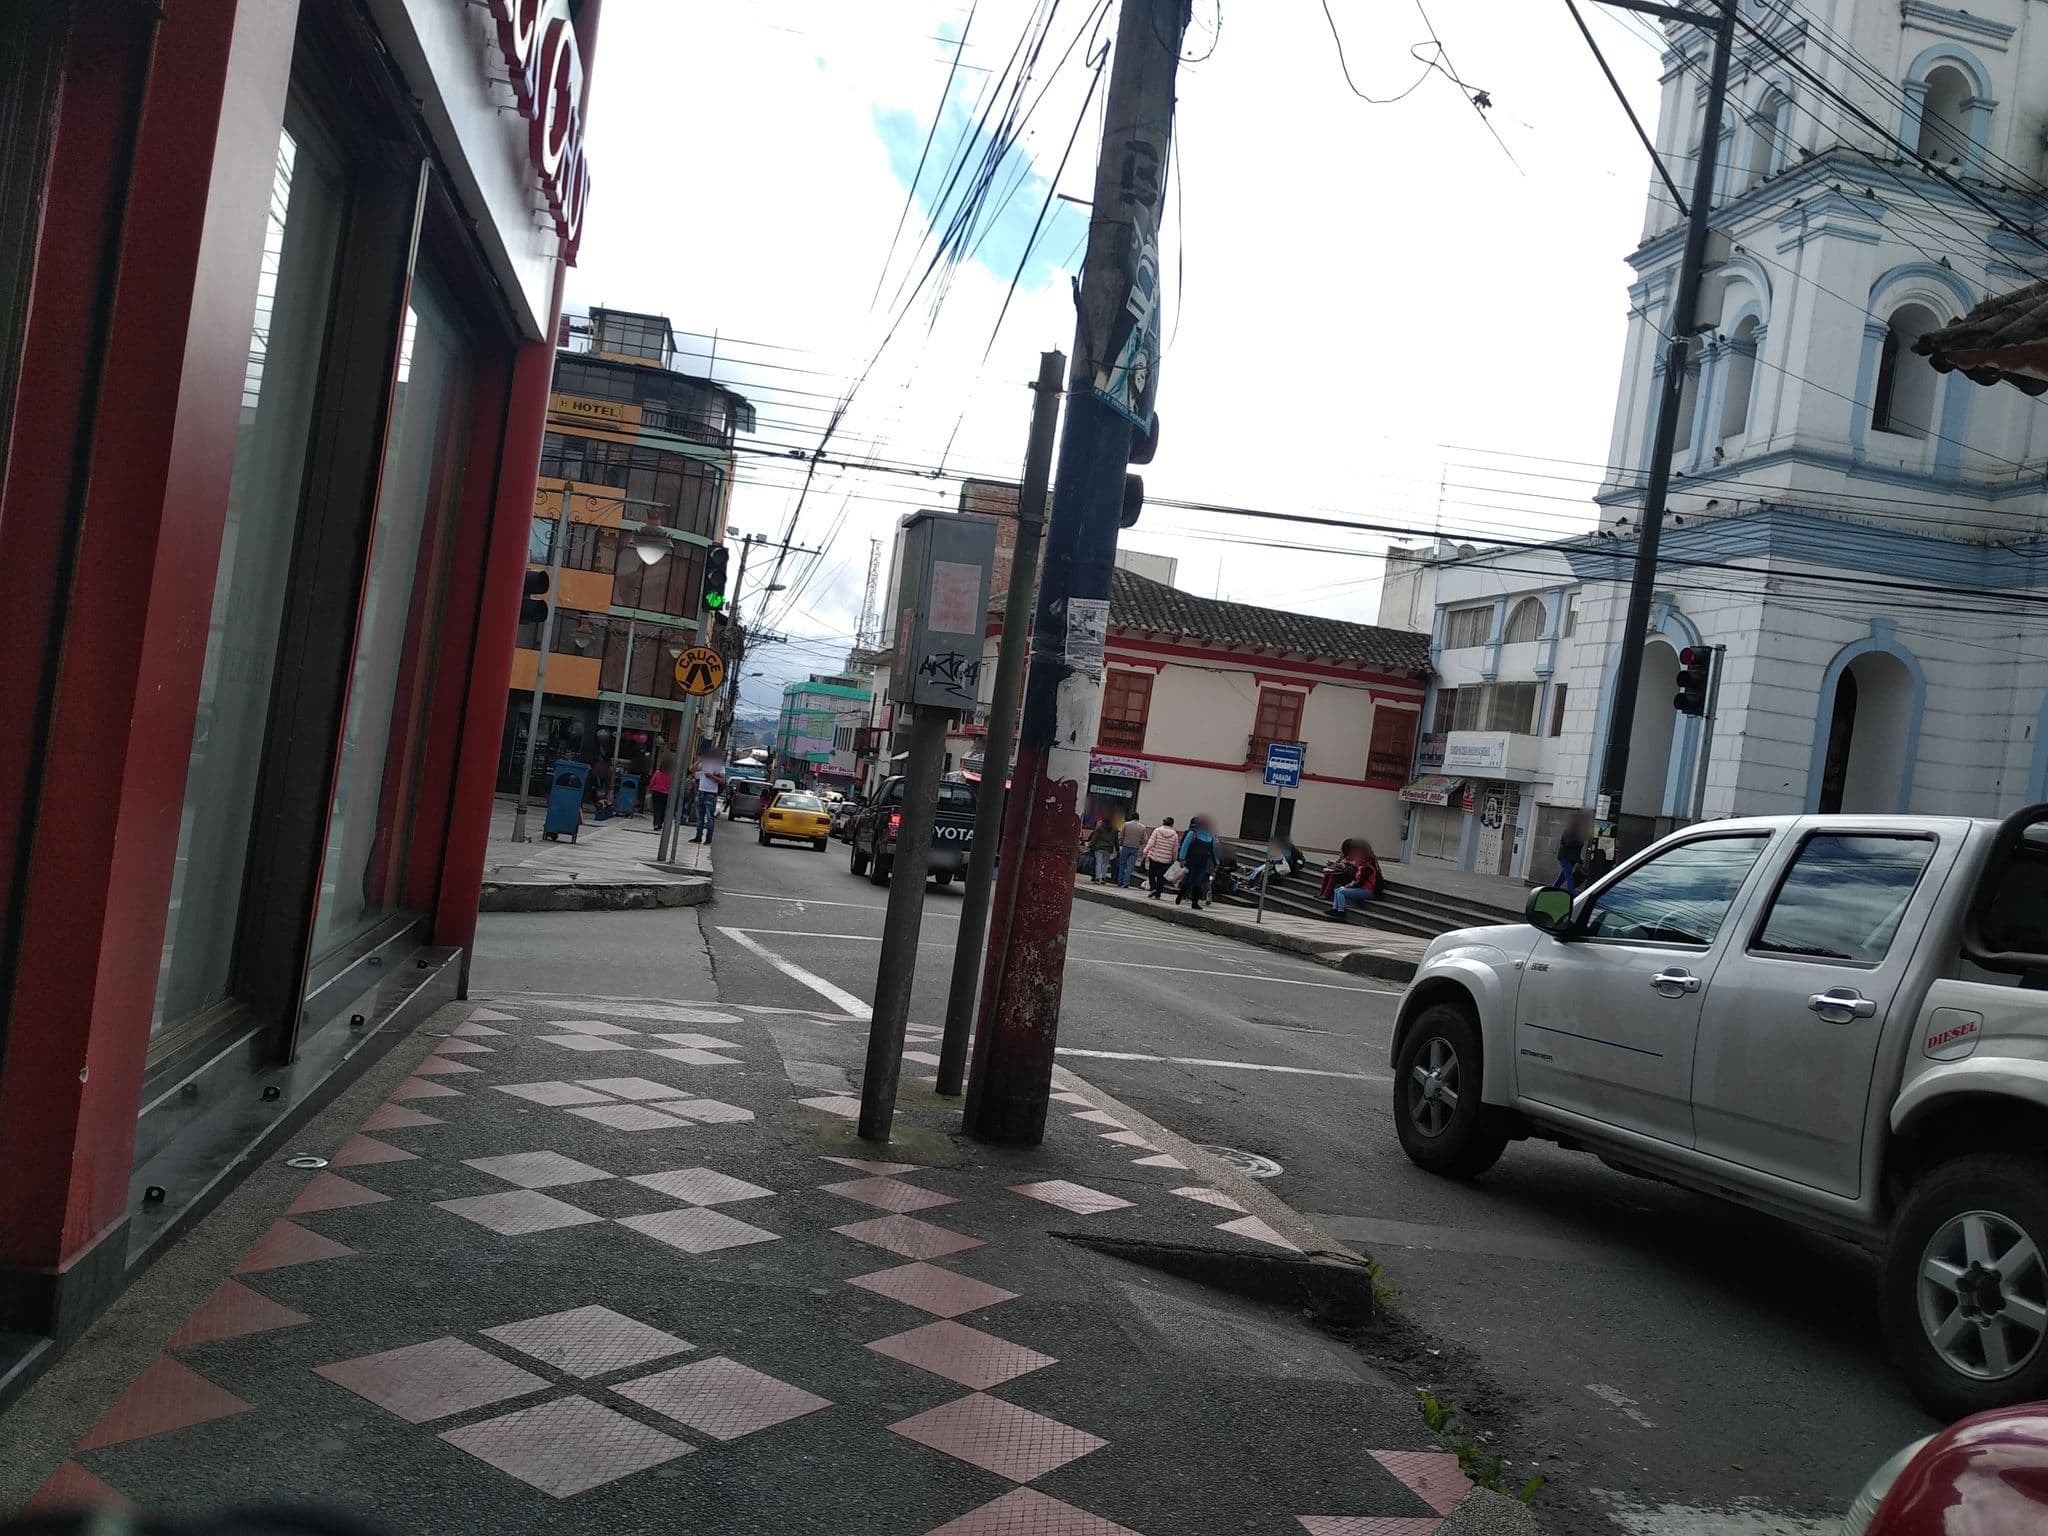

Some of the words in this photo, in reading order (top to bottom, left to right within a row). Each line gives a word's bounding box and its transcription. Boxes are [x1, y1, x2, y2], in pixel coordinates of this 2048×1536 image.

[572, 401, 619, 417] HOTEL
[679, 650, 721, 672] CRUCE
[1089, 765, 1148, 779] ANTASIA
[933, 825, 975, 841] YOTA
[1927, 1020, 1977, 1049] DIESEL
